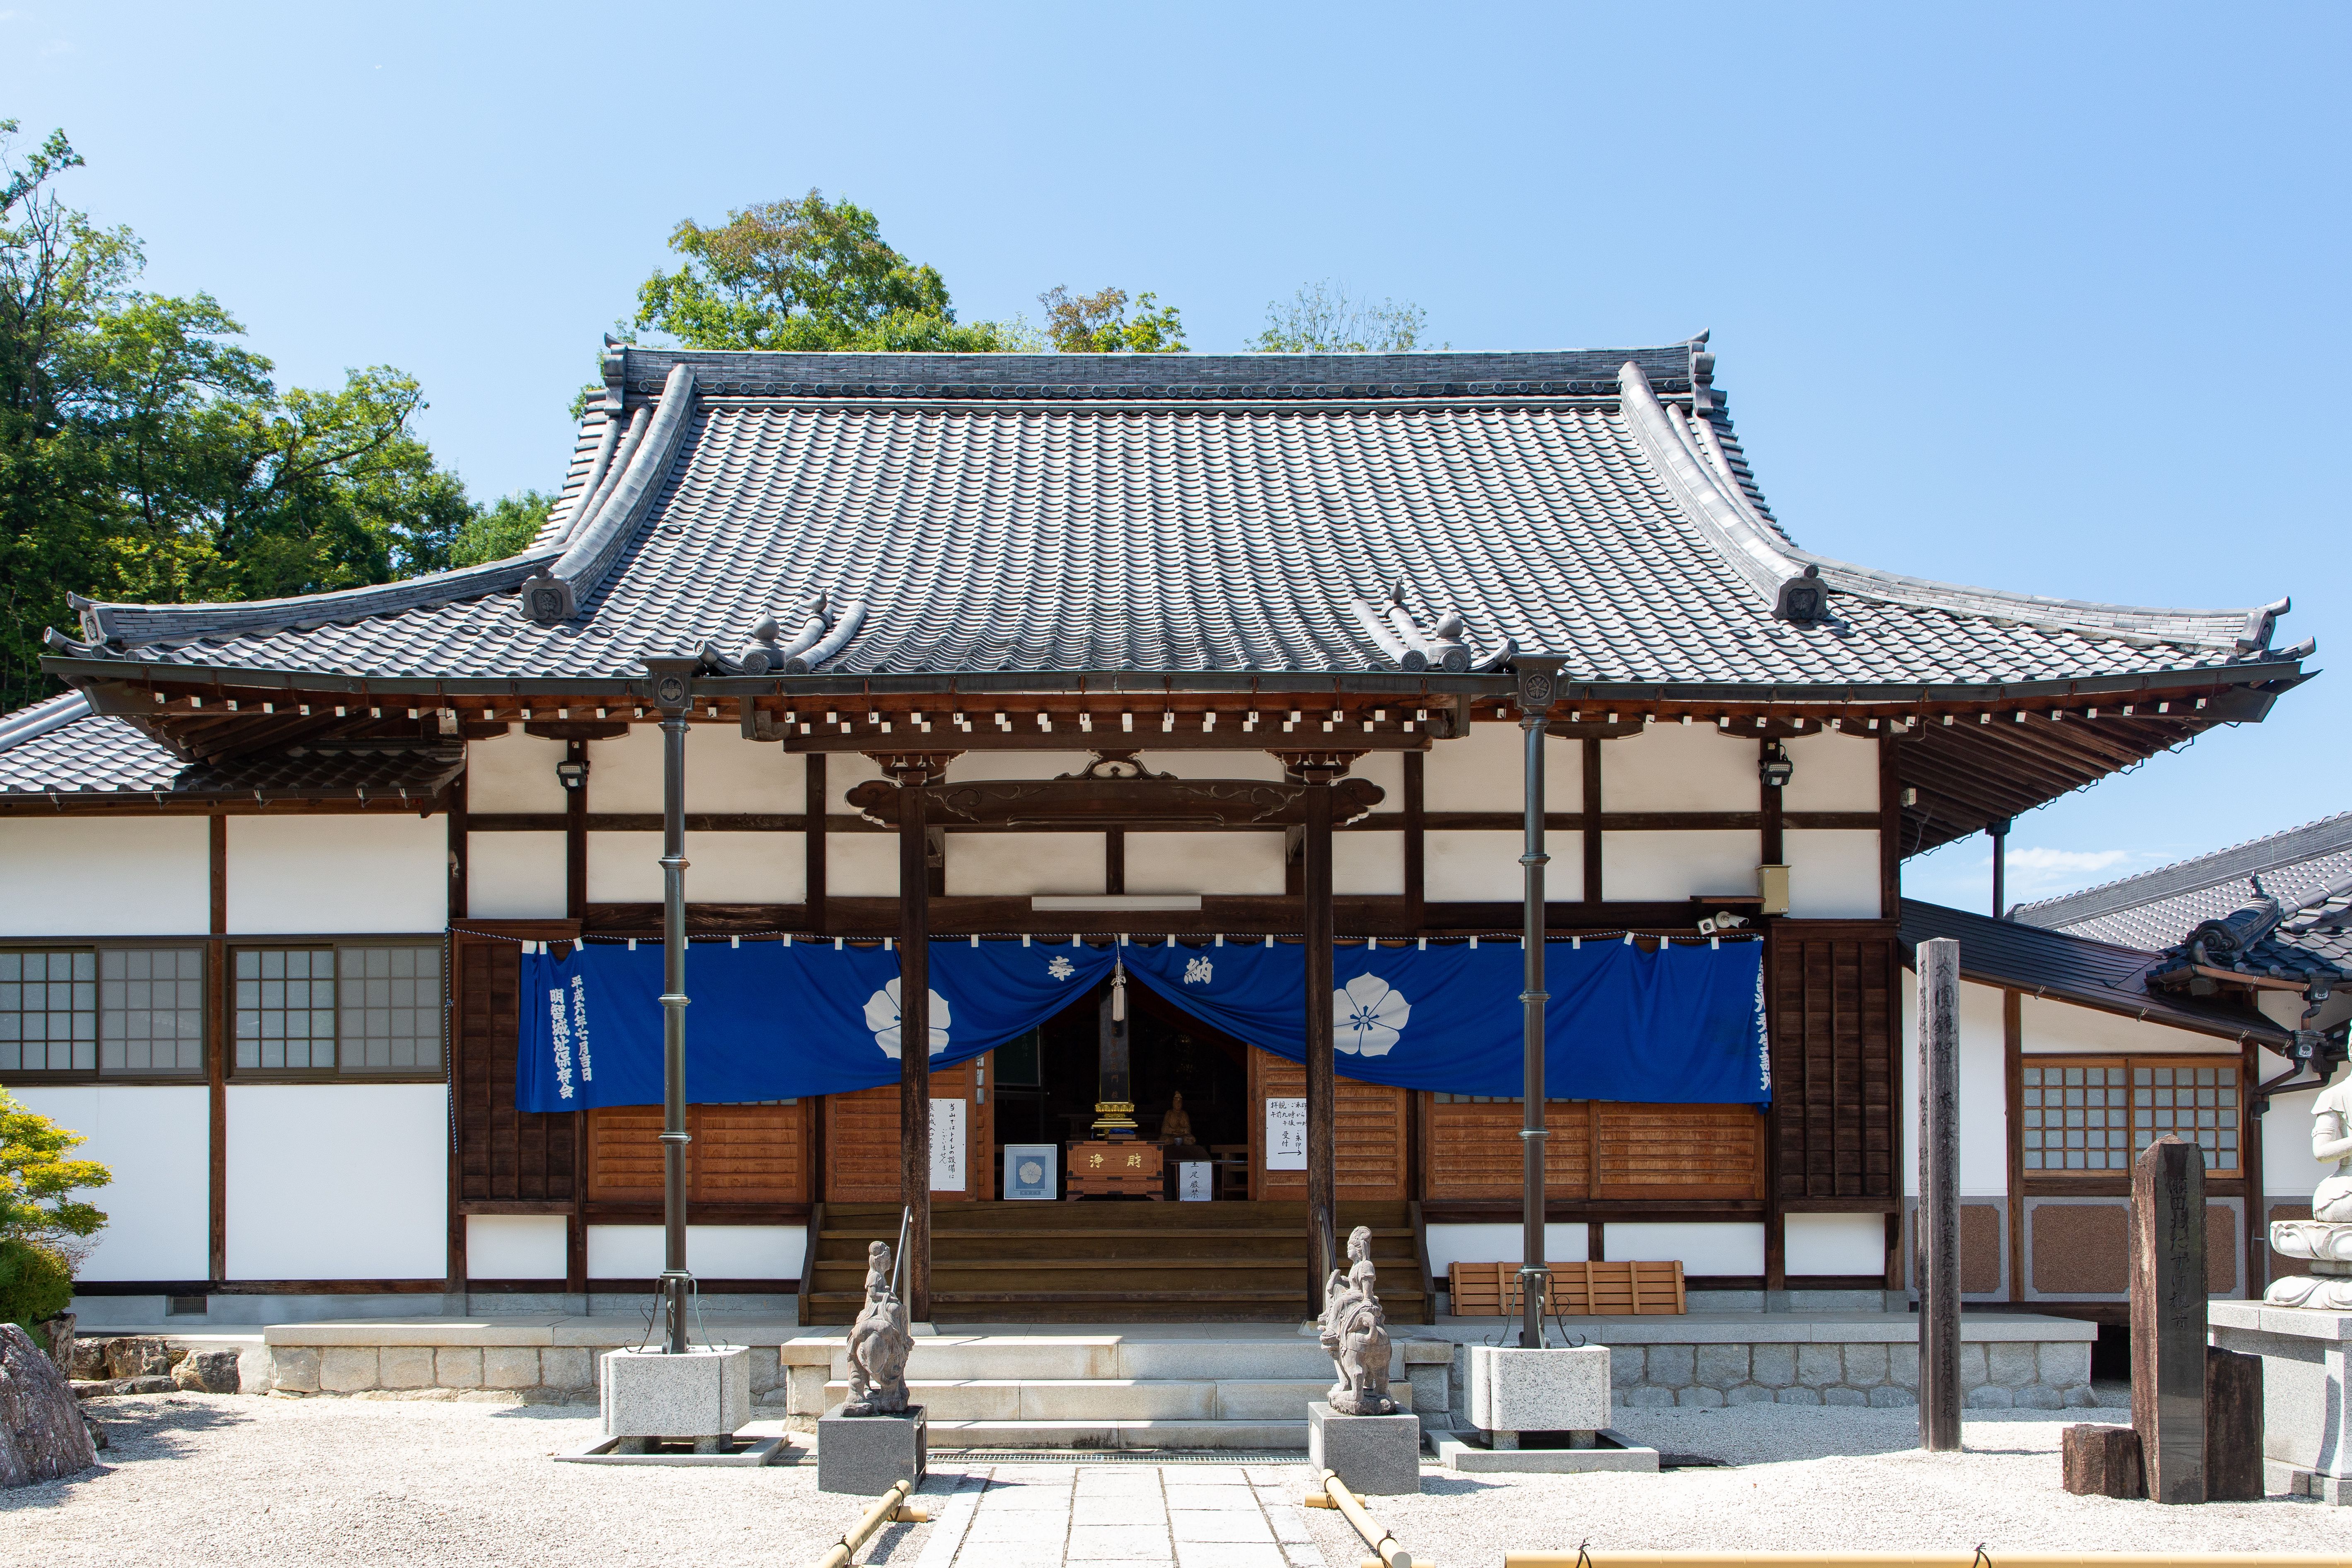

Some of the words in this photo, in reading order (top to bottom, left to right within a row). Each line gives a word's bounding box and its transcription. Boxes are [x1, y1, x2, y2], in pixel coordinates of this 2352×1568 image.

[1048, 956, 1075, 981] 奉
[1184, 956, 1213, 984] 納
[549, 988, 574, 1099] 明智城址保存会
[571, 975, 593, 1082] 平成六年七月吉日
[948, 1103, 956, 1179] 当山ではトイレの設備に
[1282, 1130, 1290, 1147] 受付
[1089, 1153, 1142, 1168] 浄財
[1189, 1162, 1200, 1199] 土足厳禁
